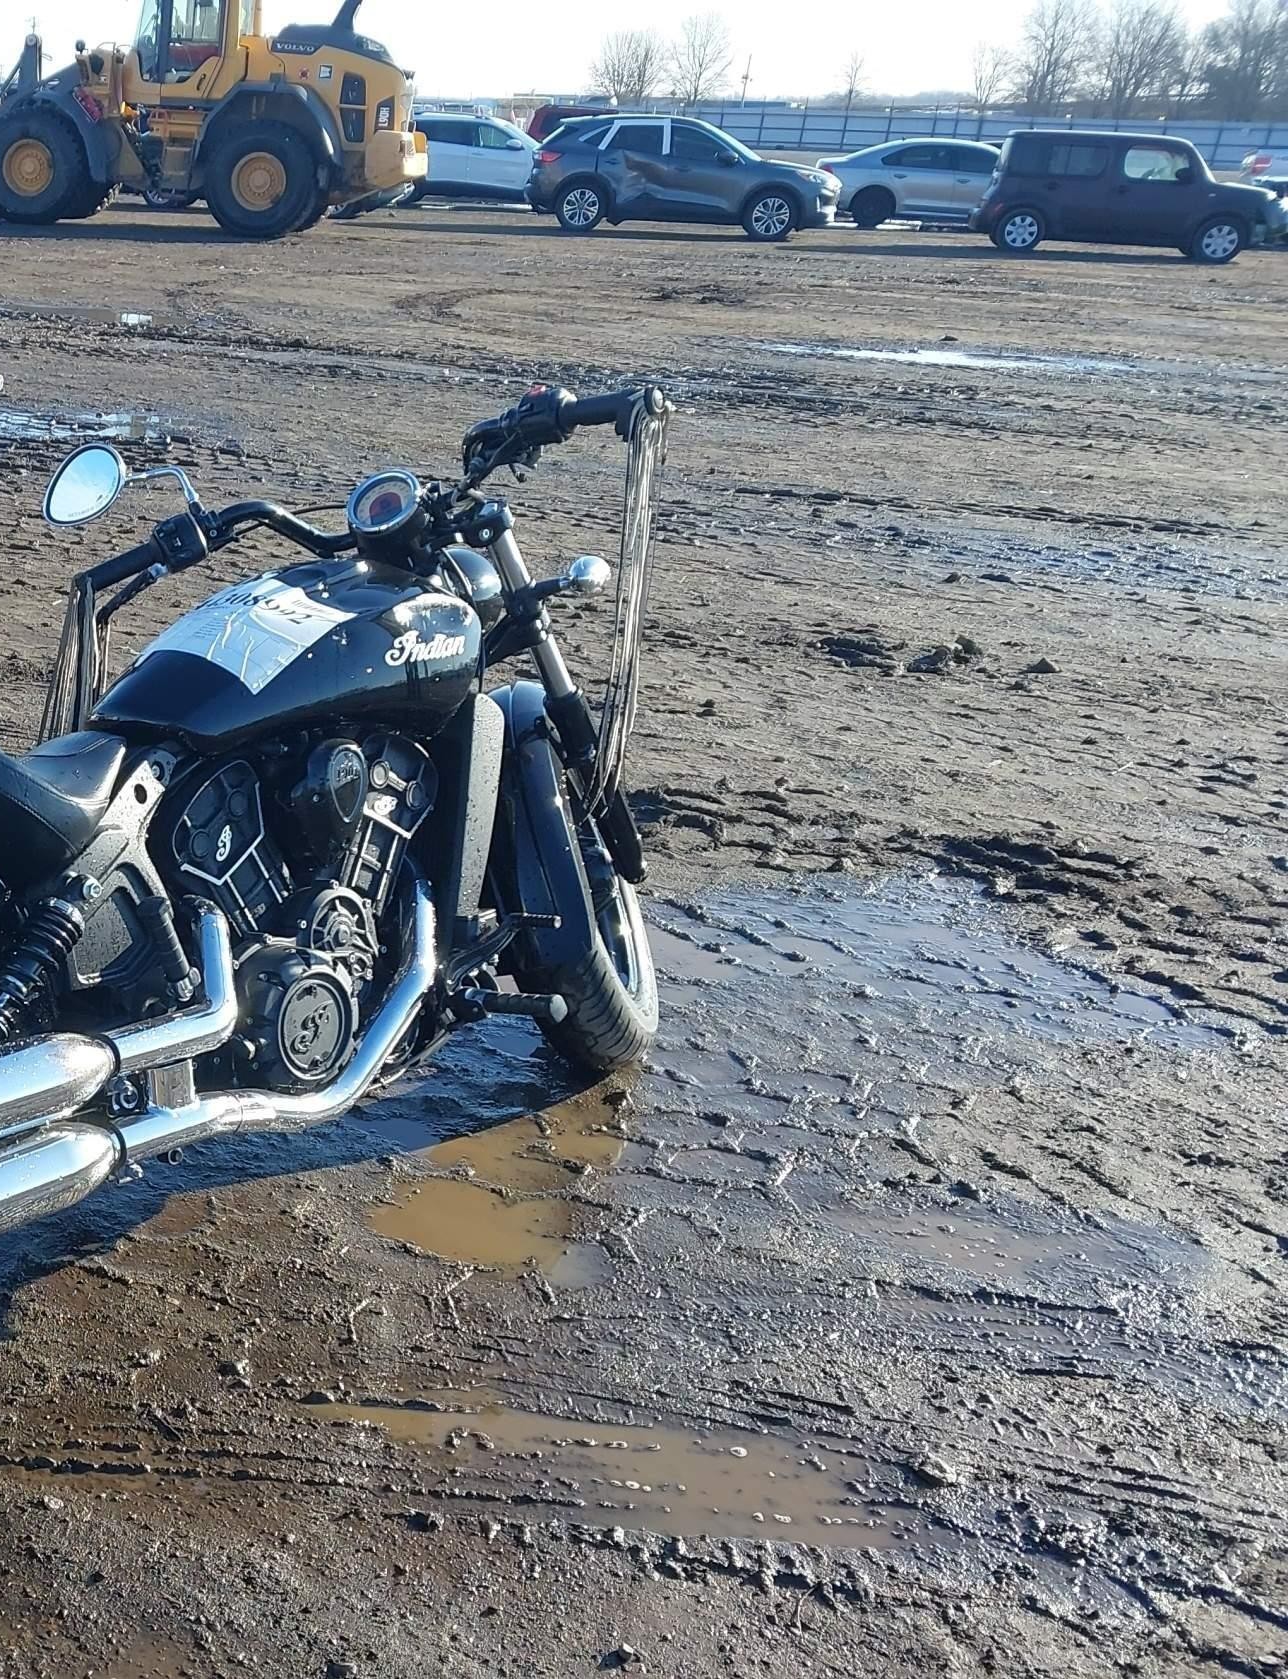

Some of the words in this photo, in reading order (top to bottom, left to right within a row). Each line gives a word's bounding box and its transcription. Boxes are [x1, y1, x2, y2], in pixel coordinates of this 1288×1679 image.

[276, 42, 315, 52] VOLVO
[378, 106, 390, 127] L90H
[384, 630, 466, 667] Indian
